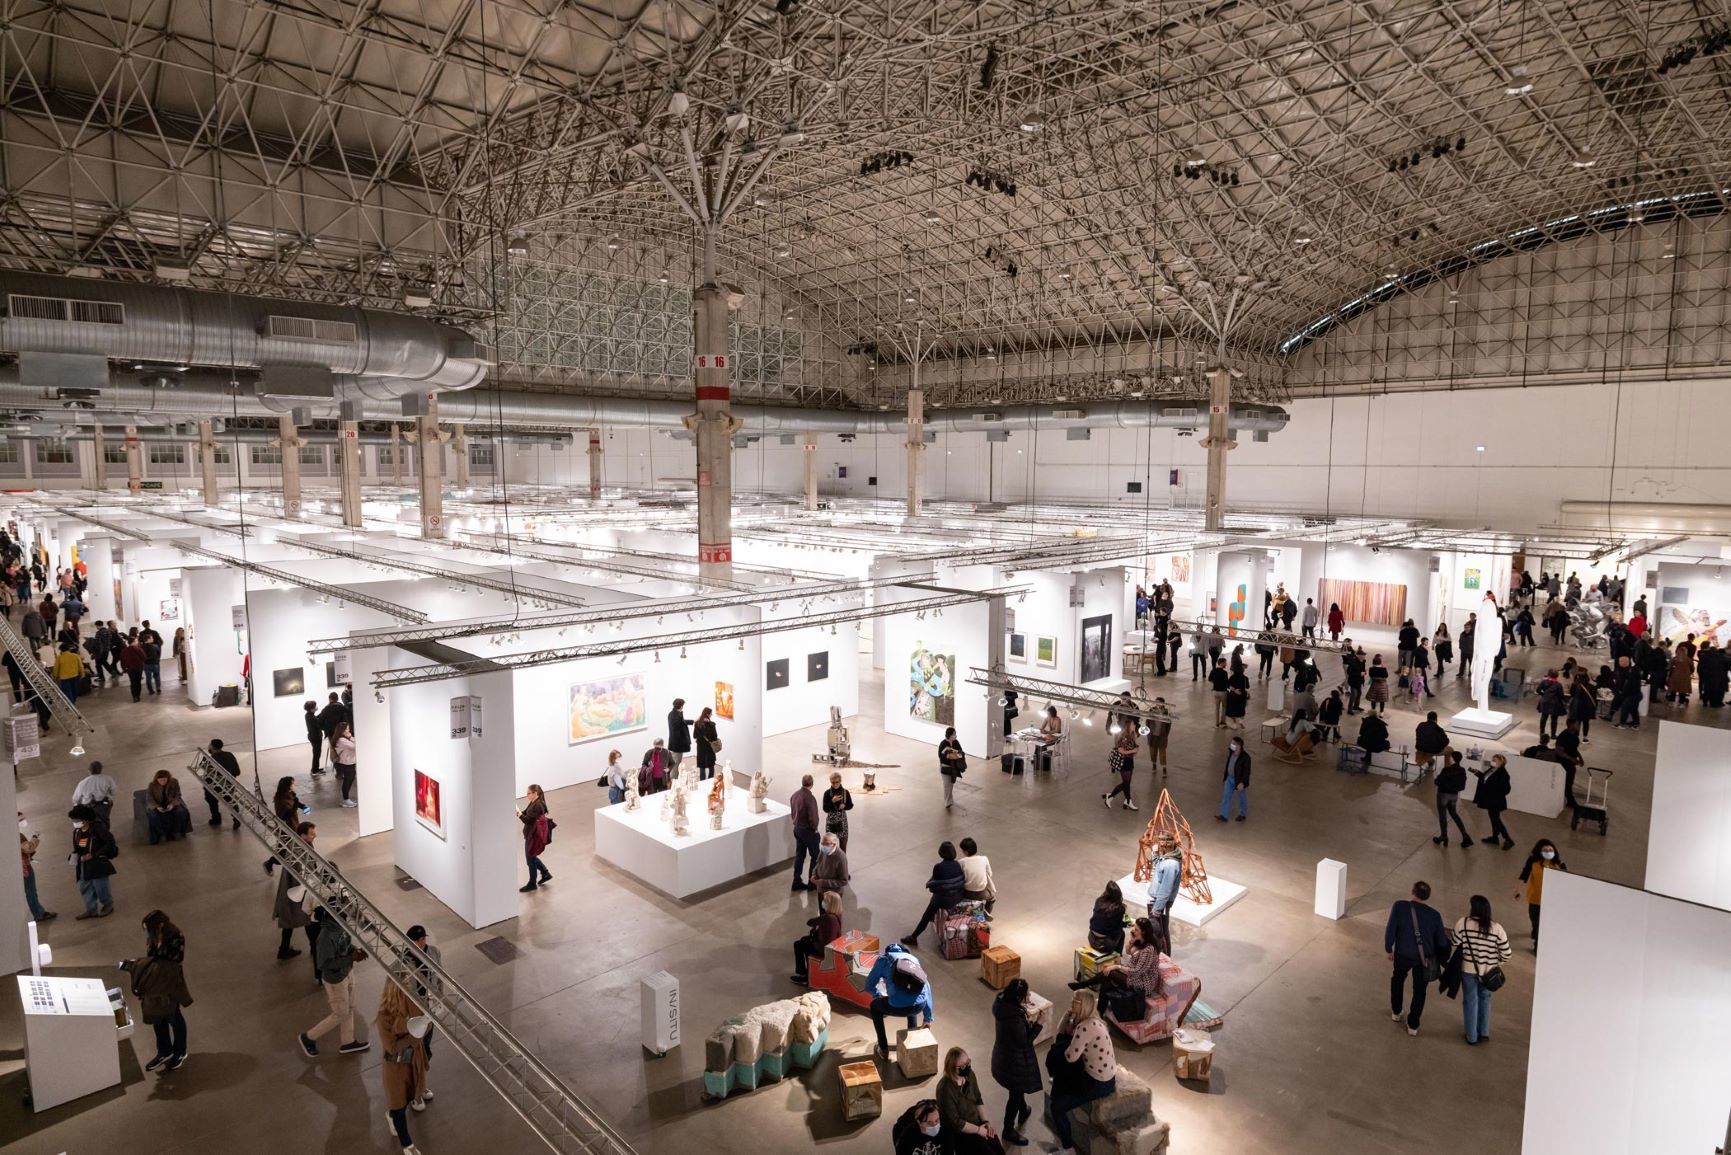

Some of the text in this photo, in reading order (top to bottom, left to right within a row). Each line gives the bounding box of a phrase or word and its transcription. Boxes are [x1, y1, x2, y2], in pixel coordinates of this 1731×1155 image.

[698, 356, 706, 368] 16
[714, 356, 725, 368] 16
[451, 727, 467, 735] 339
[668, 988, 678, 1041] IN/SITU
